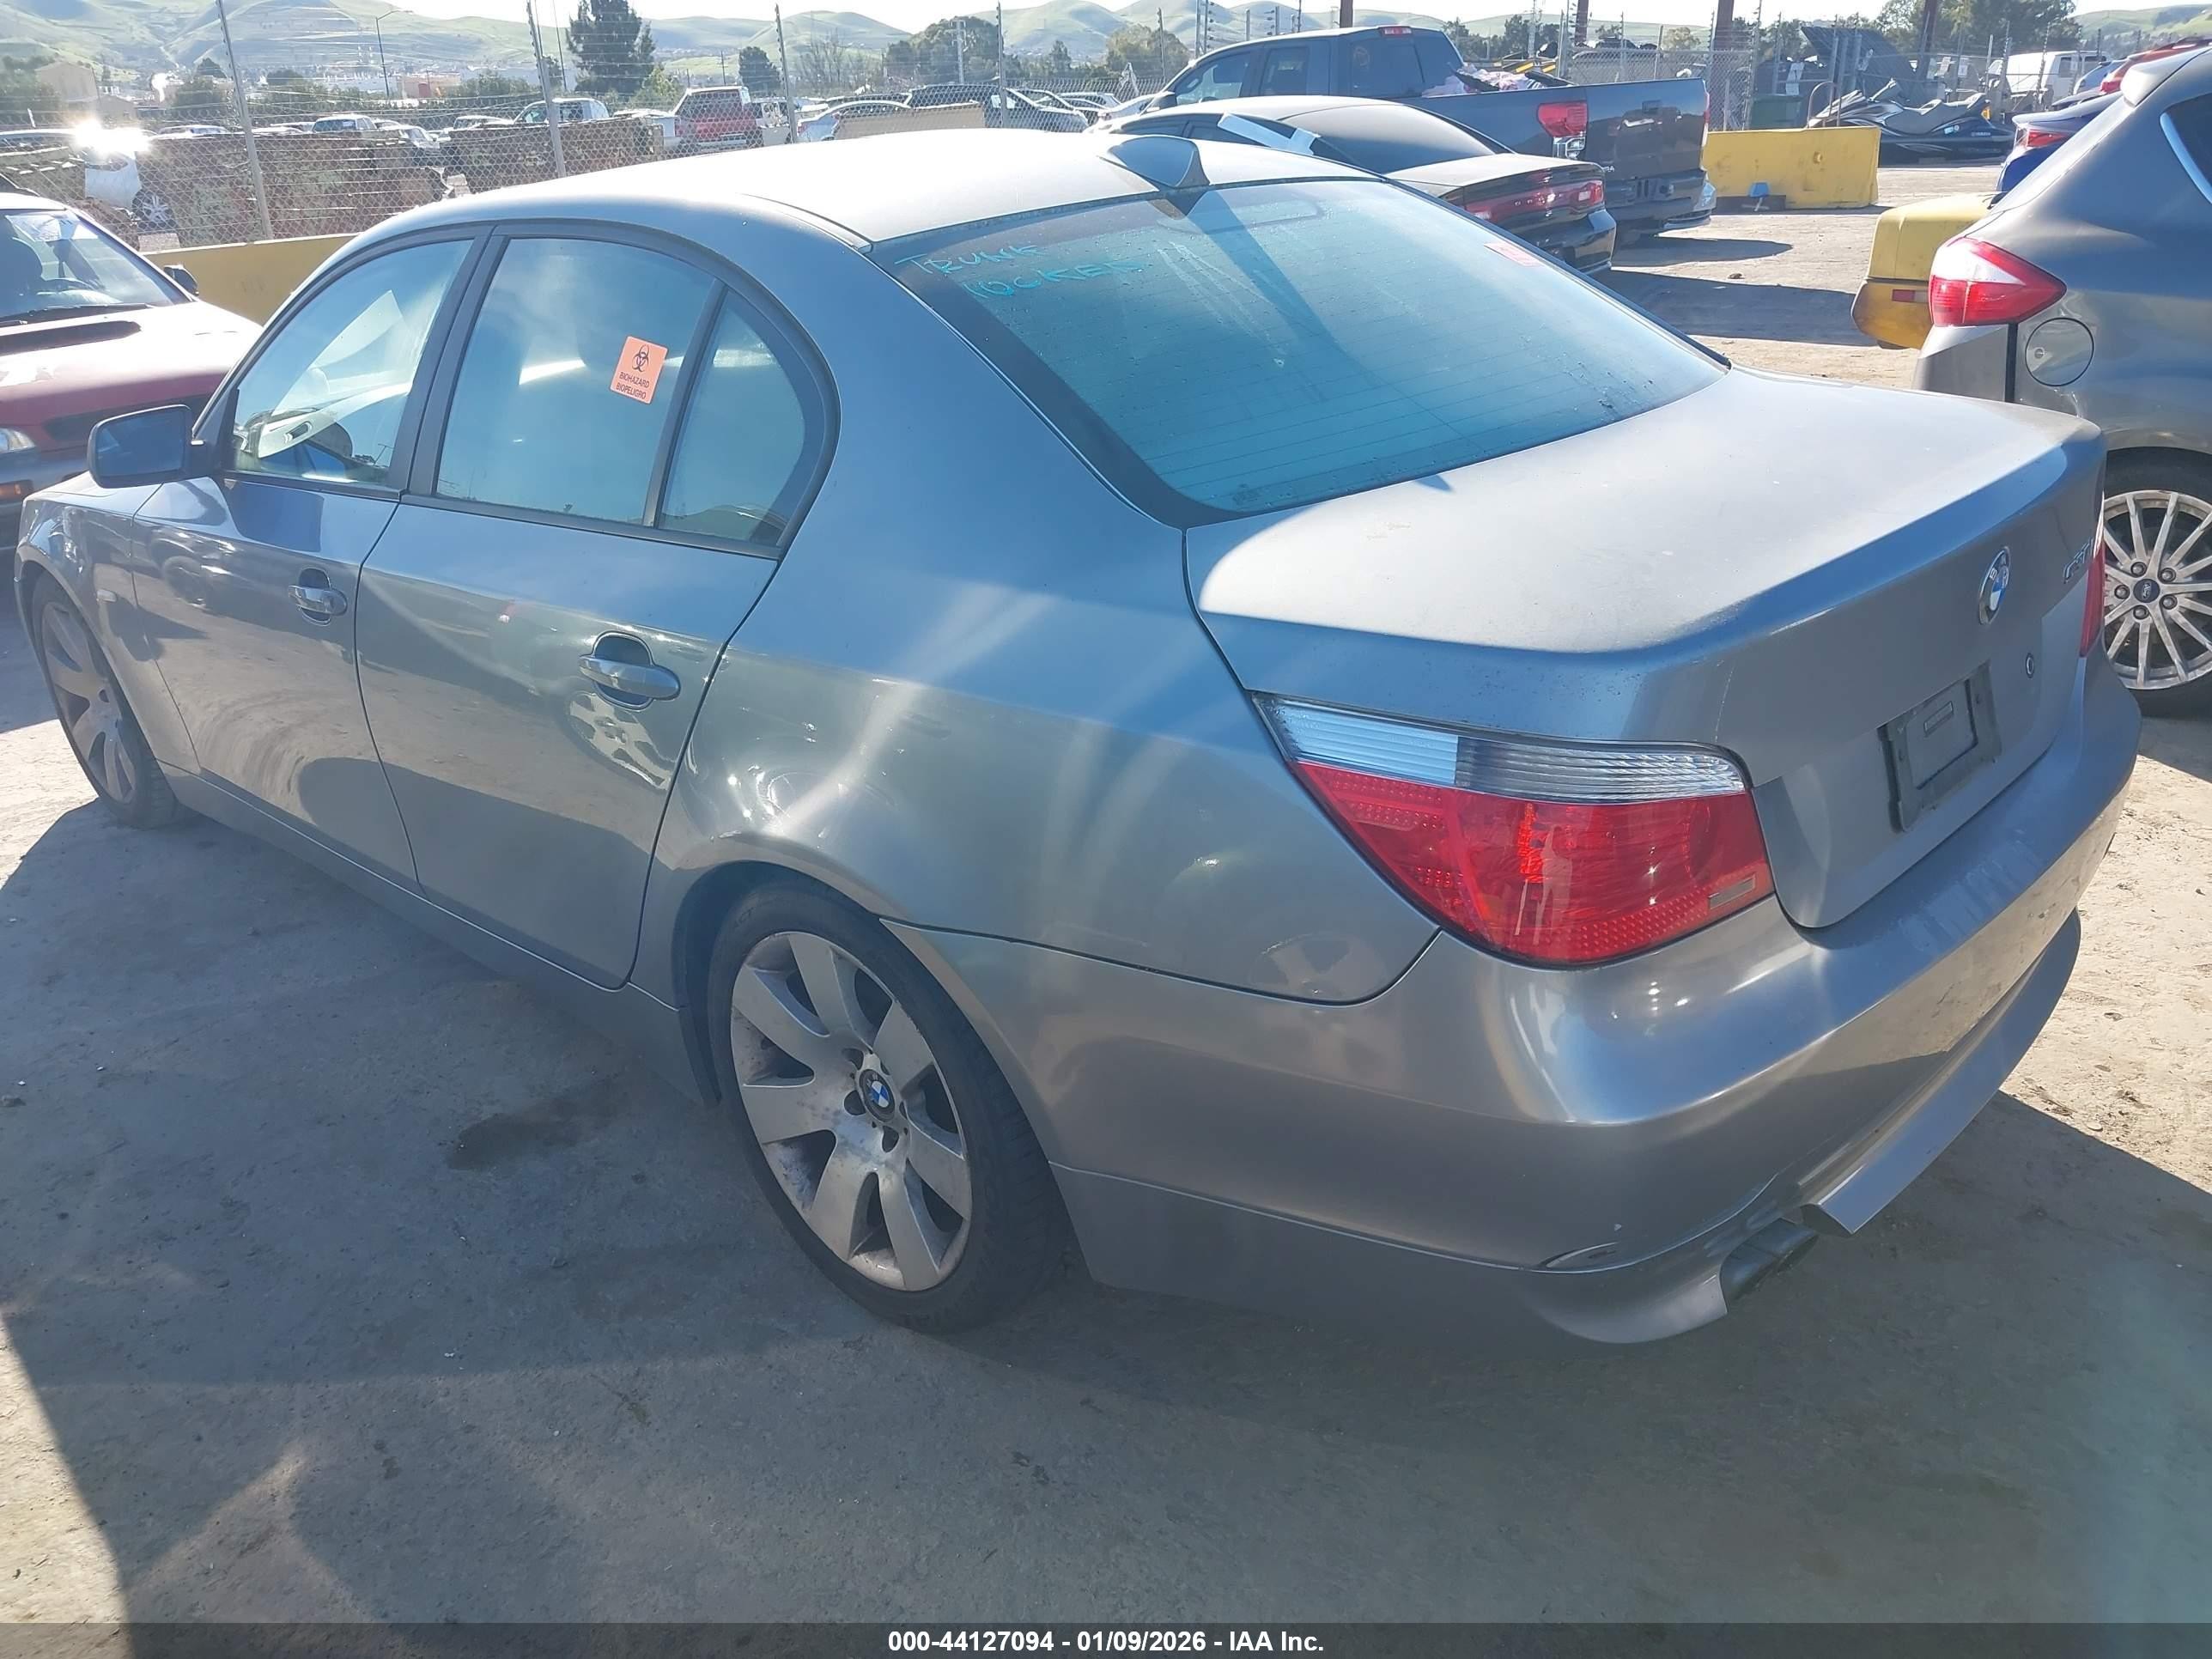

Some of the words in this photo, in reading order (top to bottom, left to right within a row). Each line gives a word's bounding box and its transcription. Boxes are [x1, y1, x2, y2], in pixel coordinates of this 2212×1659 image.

[894, 245, 1045, 274] TRUNK
[619, 372, 650, 388] BIOHAZARD
[616, 382, 647, 399] BIOPELIGRO
